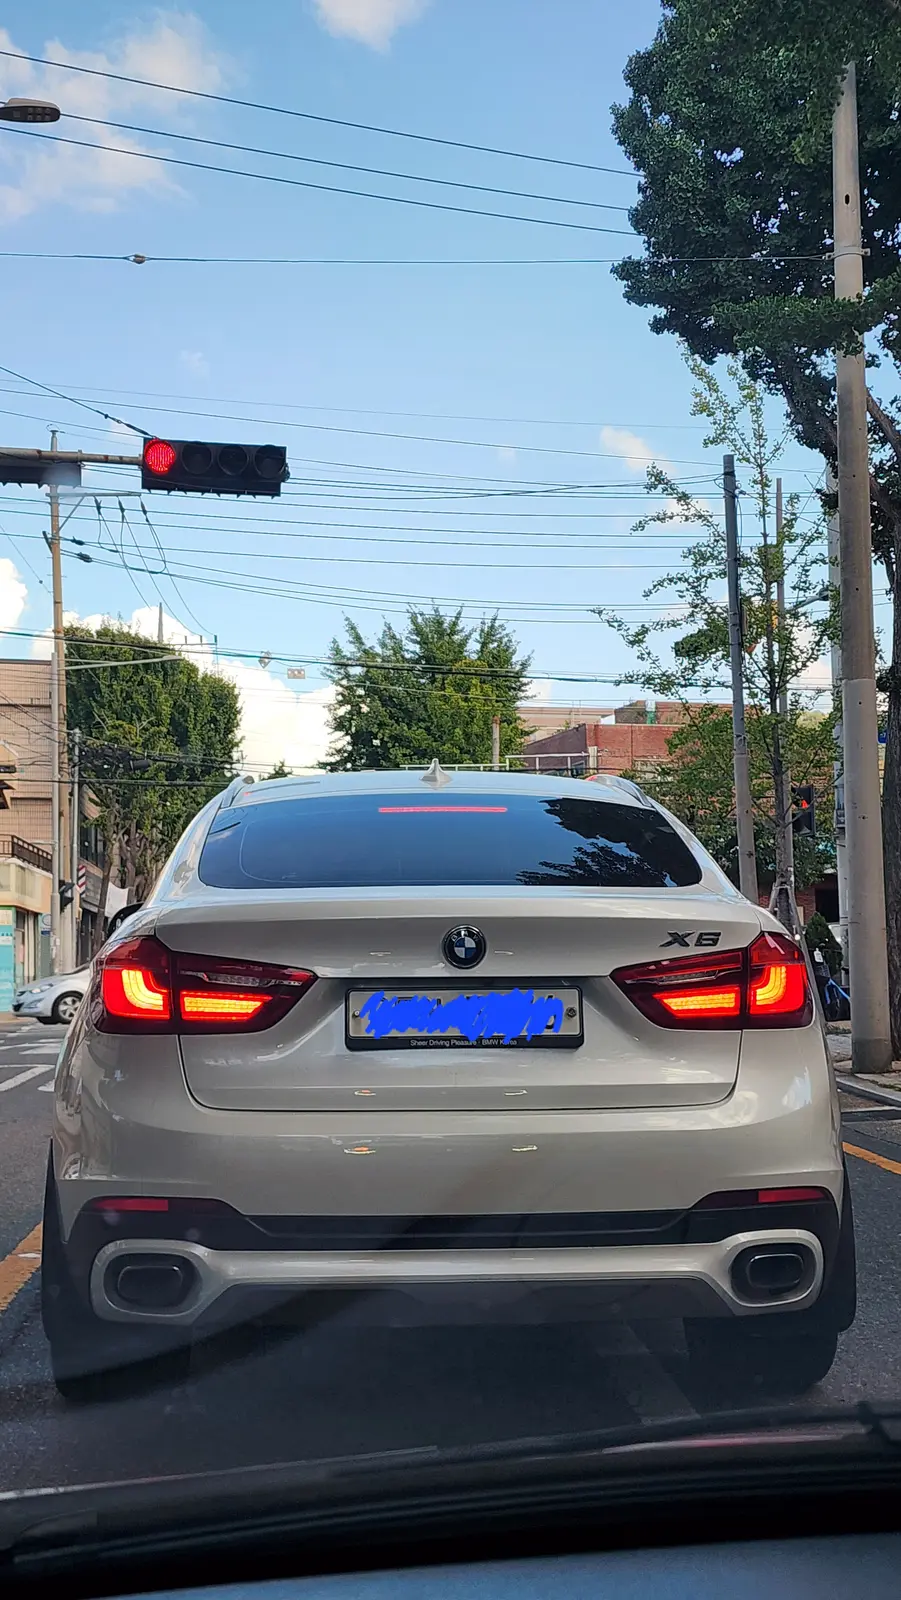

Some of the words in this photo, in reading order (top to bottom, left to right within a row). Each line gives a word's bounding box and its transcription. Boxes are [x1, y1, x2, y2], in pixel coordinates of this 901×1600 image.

[450, 930, 479, 942] BMW
[658, 930, 722, 947] X6
[429, 1039, 450, 1047] Driving
